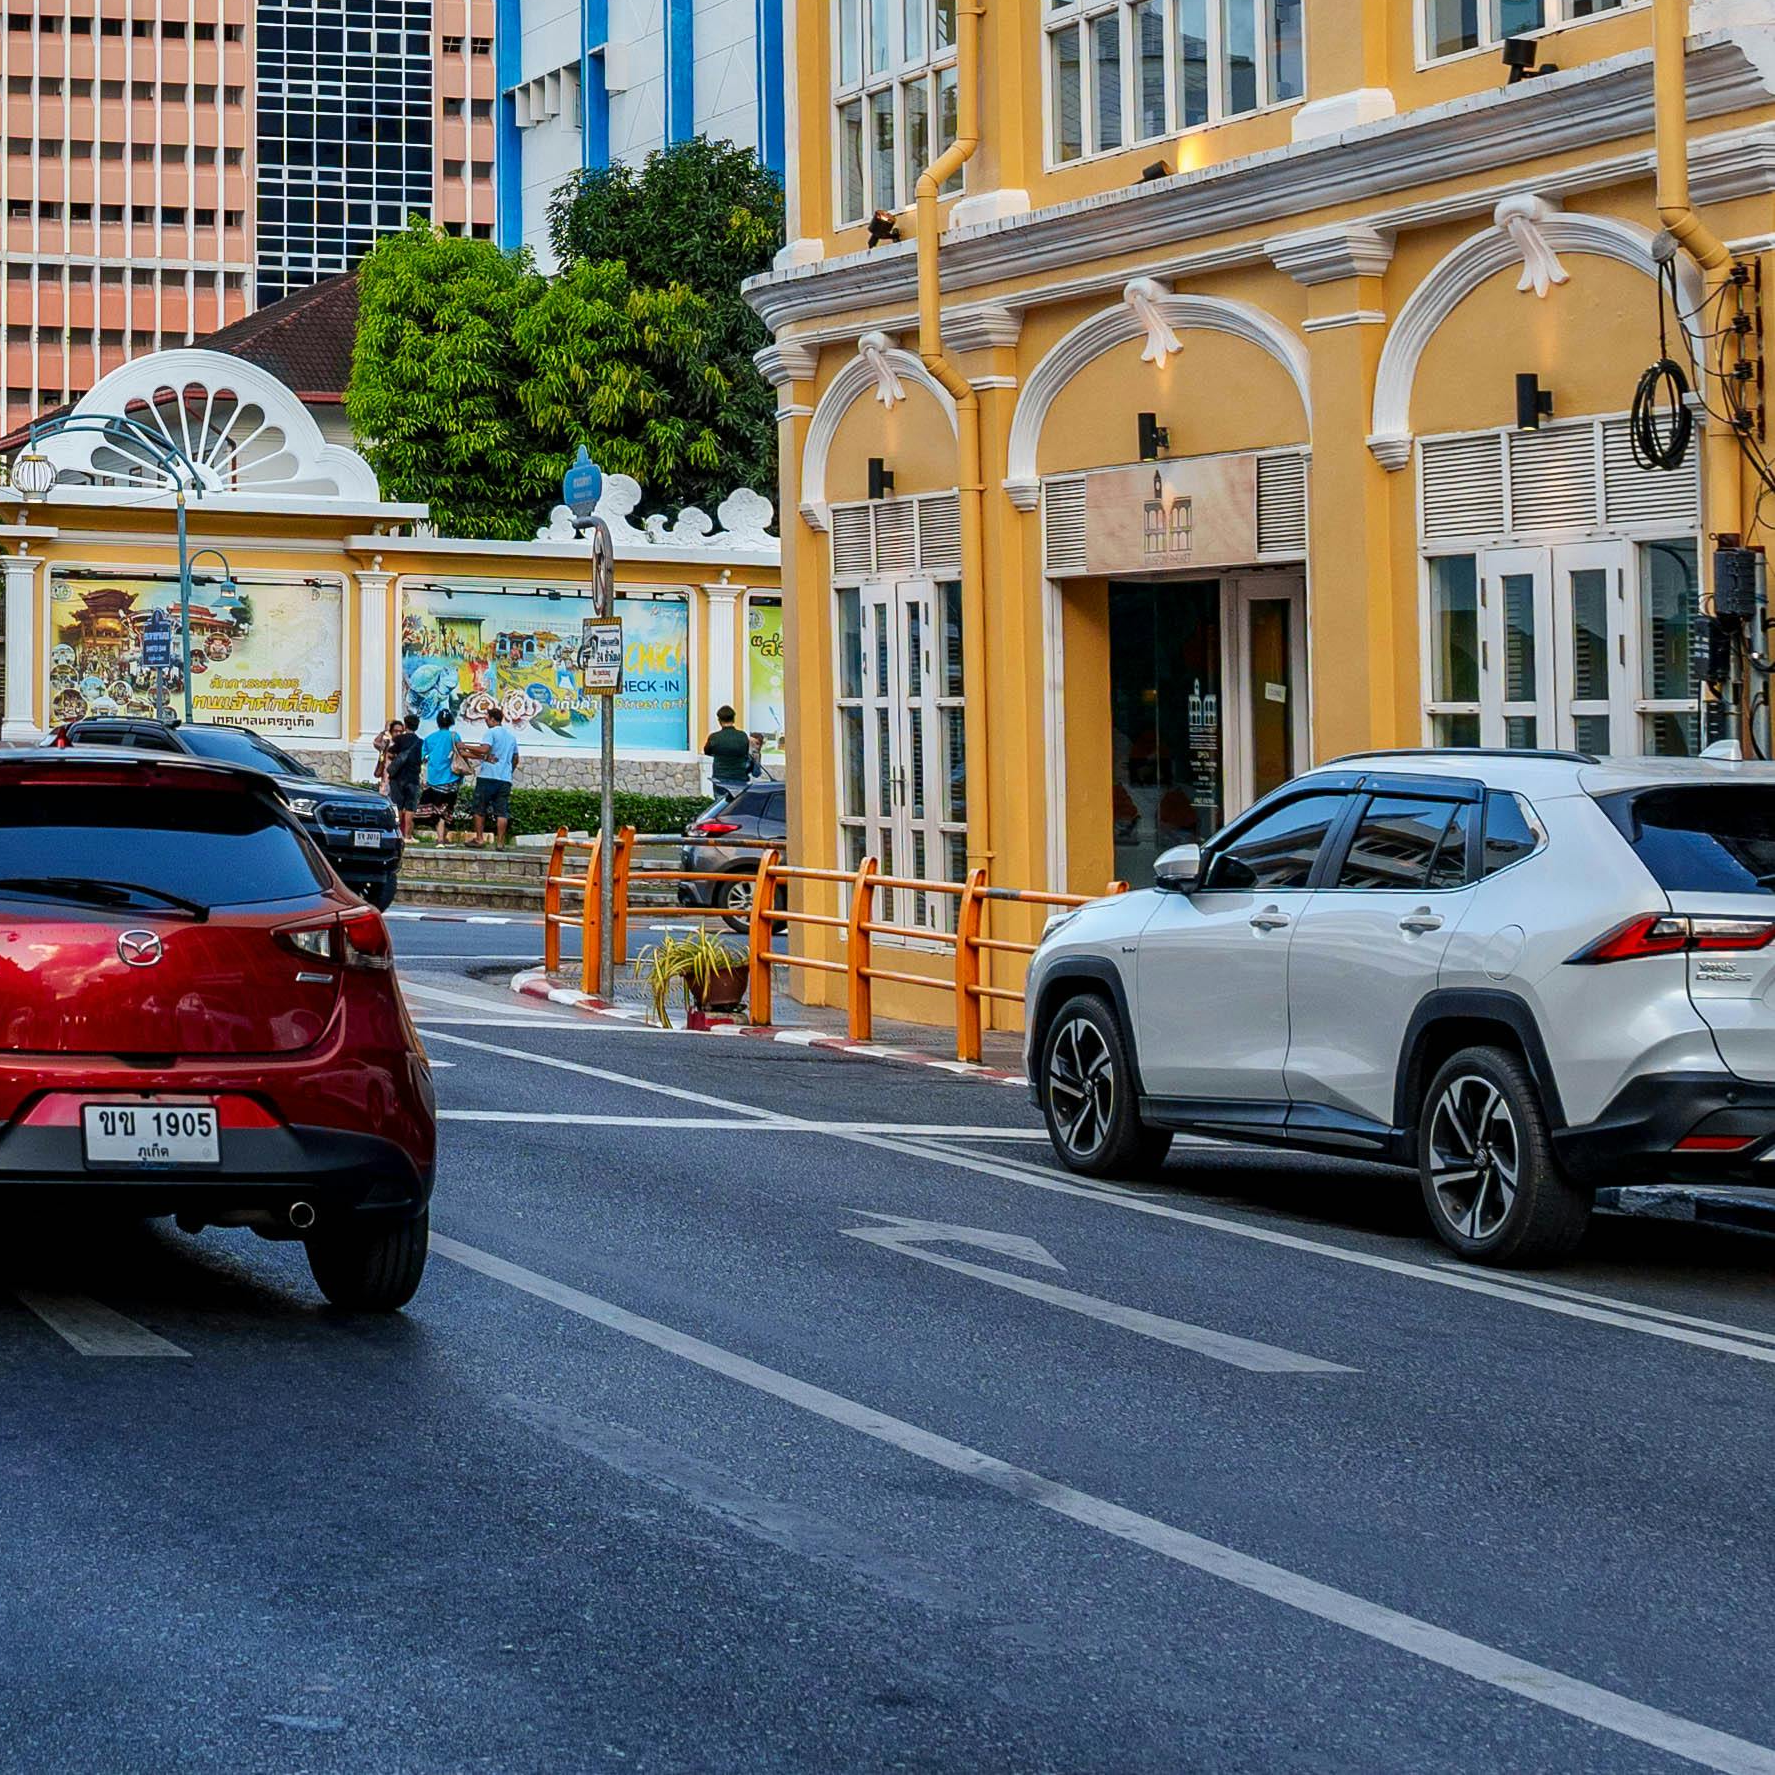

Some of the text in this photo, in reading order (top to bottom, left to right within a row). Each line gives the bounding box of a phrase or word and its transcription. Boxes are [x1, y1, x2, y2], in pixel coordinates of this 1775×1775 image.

[624, 680, 657, 693] HECK
[192, 689, 342, 715] ทพเจ้าศักดิ์สิทธิ์
[152, 1112, 212, 1137] 1905
